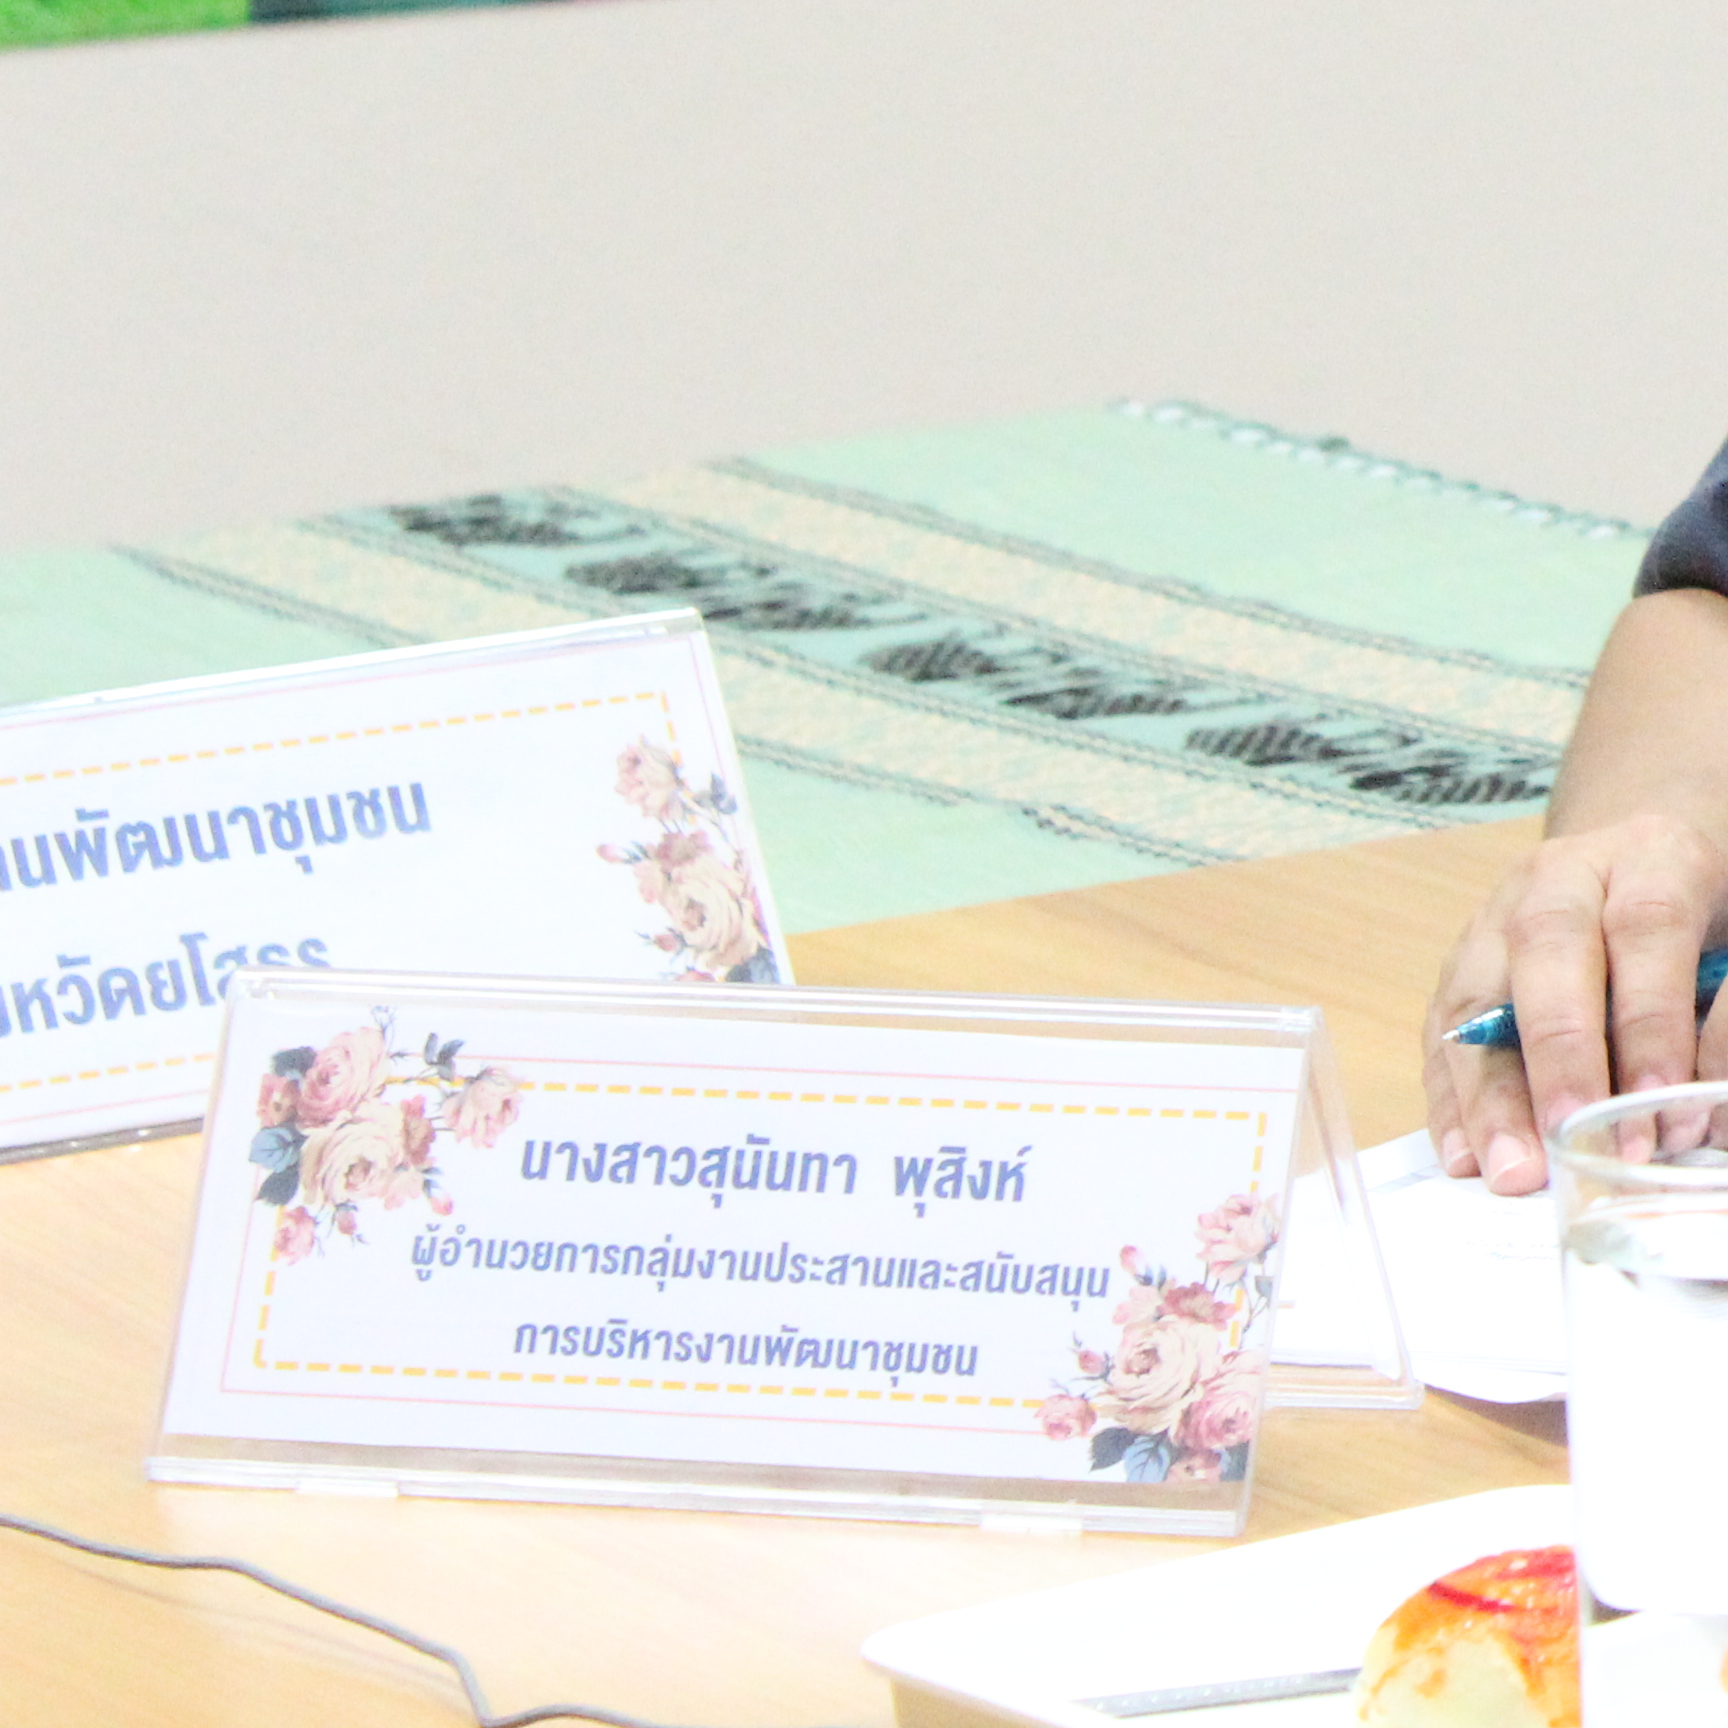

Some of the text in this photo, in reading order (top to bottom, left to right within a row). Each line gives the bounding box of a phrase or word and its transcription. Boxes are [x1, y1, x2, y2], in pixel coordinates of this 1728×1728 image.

[520, 1133, 1033, 1219] นางสาวสุนันทา พุสิงห์
[410, 1222, 1110, 1313] ผู้อำนวยการกลุ่มงานประสานและสนับสนุน
[513, 1317, 979, 1388] การบริหารงานพัฒนาชุมชน
